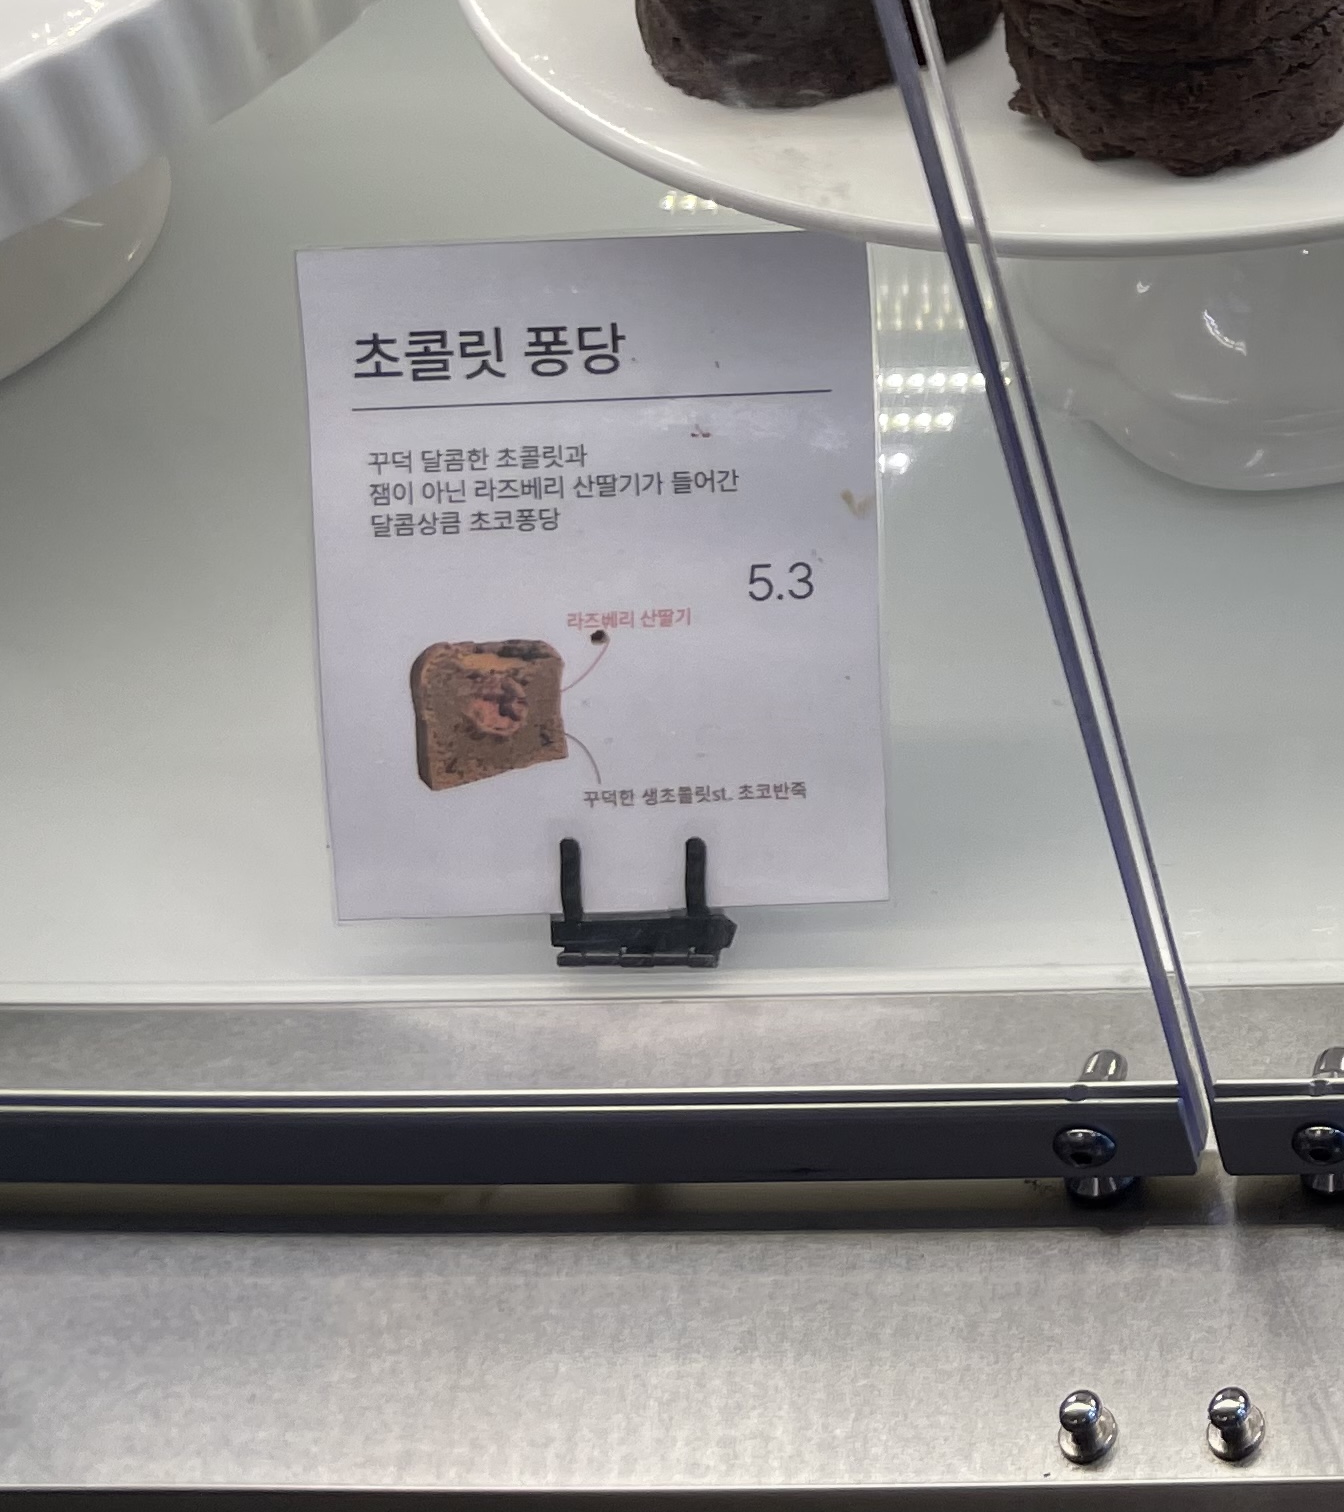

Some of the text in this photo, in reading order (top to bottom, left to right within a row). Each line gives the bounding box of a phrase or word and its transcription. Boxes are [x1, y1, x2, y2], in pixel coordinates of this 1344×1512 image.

[352, 321, 627, 382] 초콜릿 퐁당
[368, 443, 588, 476] 꾸덕 달콤한 초콜릿과
[369, 468, 740, 507] 잼이 아닌 라즈베리 산딸기가 들어간
[370, 507, 561, 538] 달콤상큼 초코퐁당
[748, 561, 815, 601] 5.3
[566, 607, 692, 631] 라즈베리 산딸기
[583, 788, 635, 808] 꾸덕한
[738, 780, 808, 801] 초코반죽
